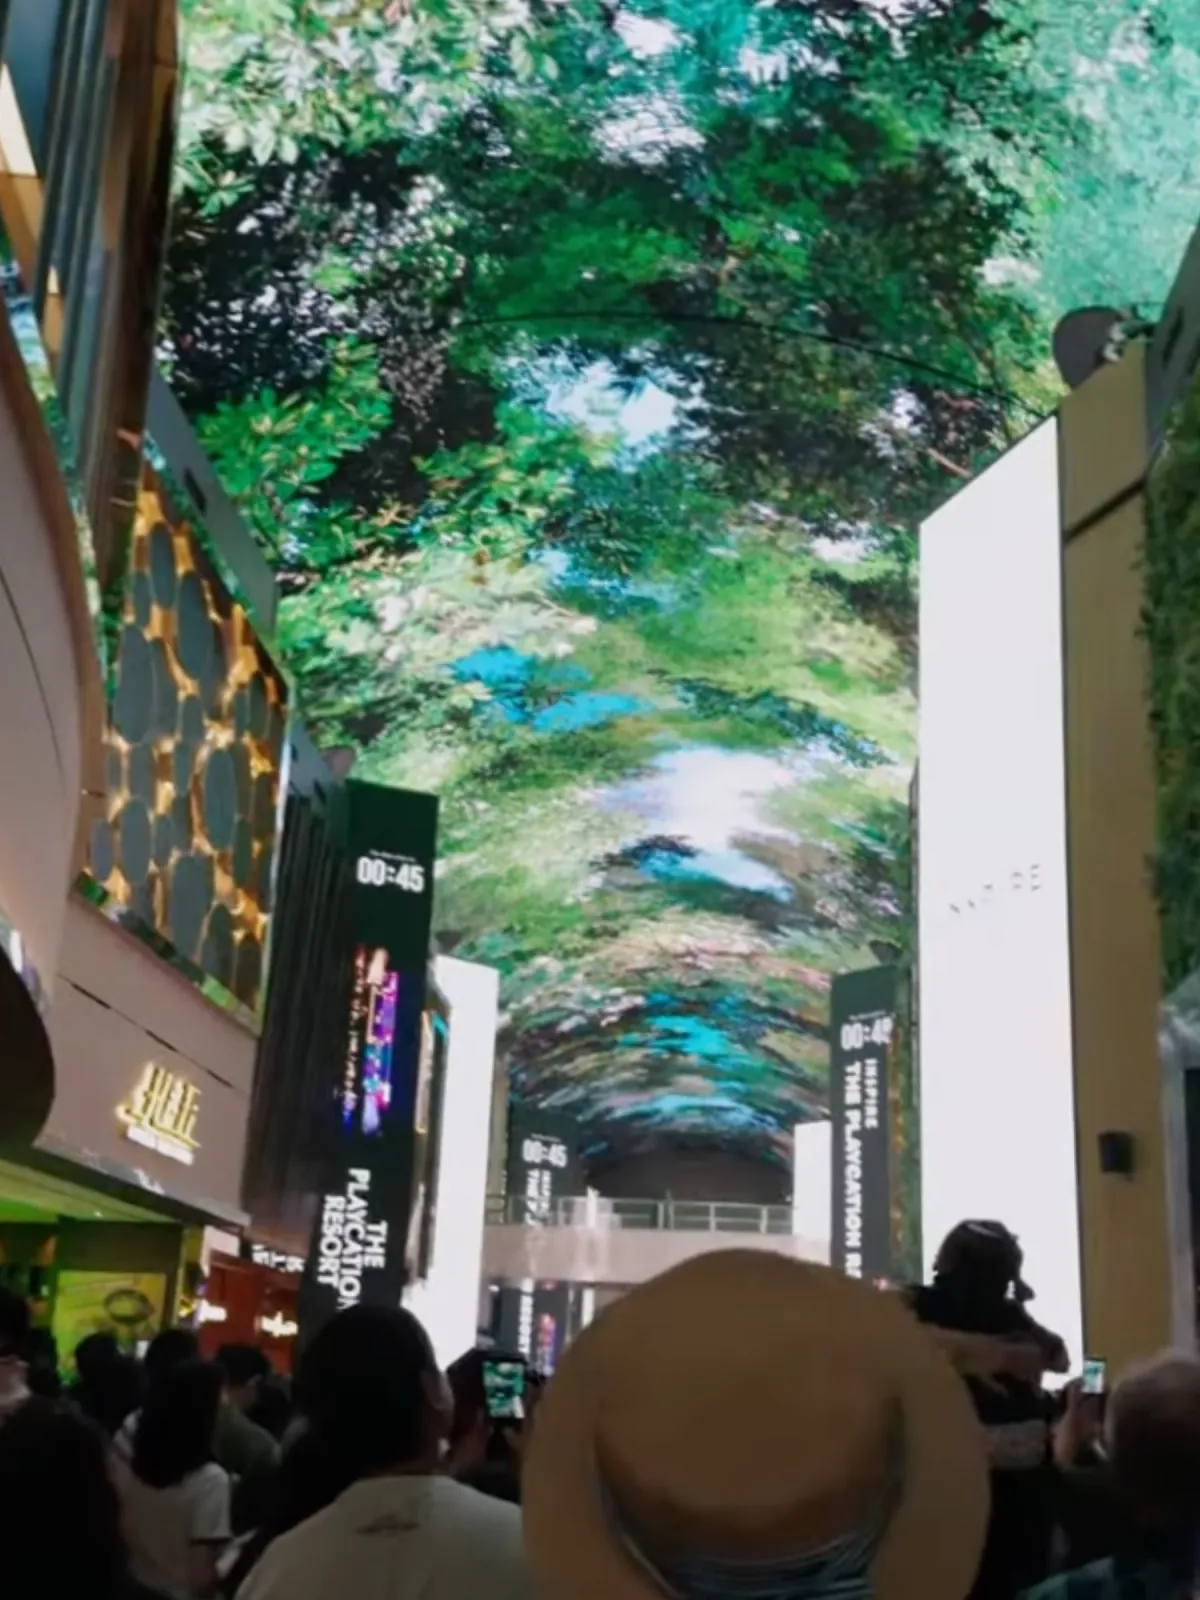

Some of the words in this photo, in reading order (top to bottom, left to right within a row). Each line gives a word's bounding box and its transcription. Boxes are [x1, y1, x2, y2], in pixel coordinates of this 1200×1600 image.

[356, 856, 425, 893] 00:45
[845, 1061, 861, 1105] THE
[845, 1109, 862, 1247] PLAYCATION
[317, 1195, 345, 1288] RESORT
[364, 1220, 388, 1268] THE
